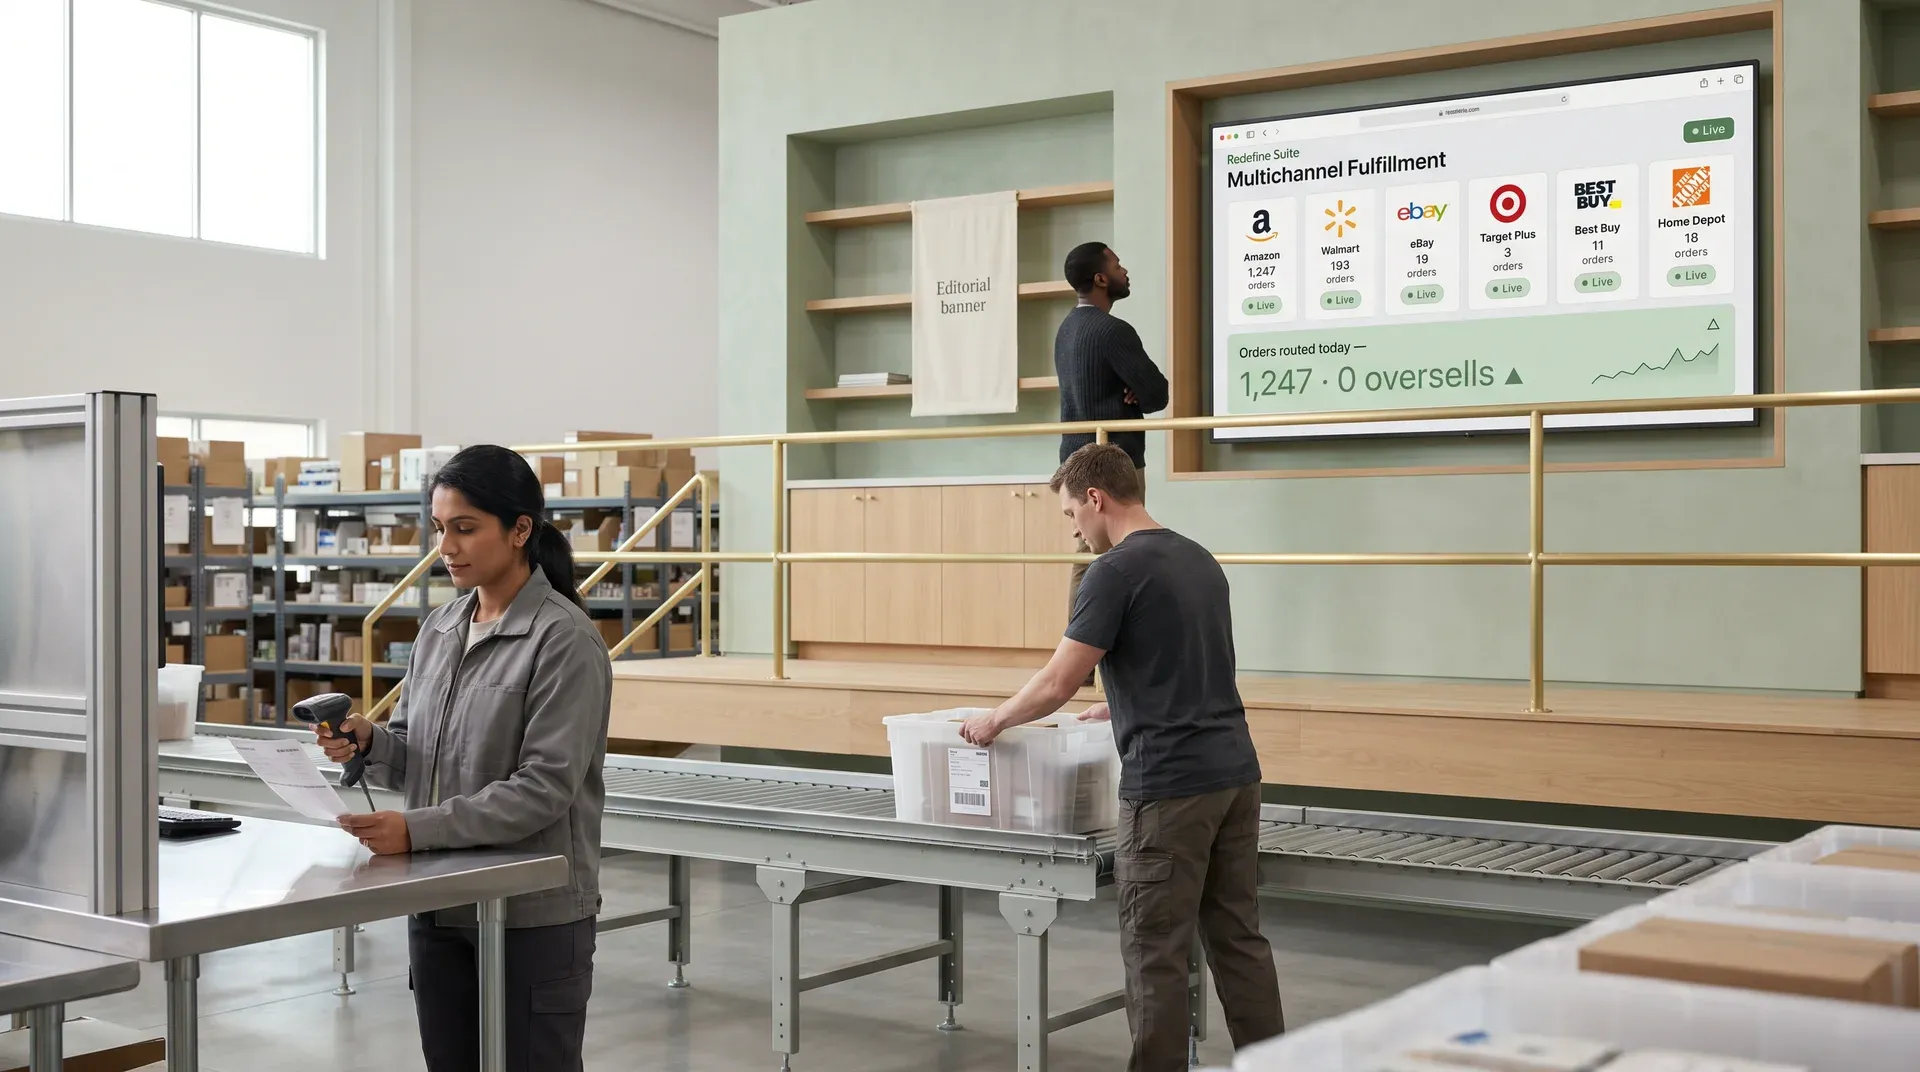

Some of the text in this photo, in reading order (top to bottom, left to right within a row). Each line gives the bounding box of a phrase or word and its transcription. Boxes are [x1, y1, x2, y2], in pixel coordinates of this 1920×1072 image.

[1703, 124, 1726, 136] Live
[1227, 148, 1300, 165] Redefine Suite
[1228, 152, 1446, 188] Multichannel Fulfillment
[1673, 166, 1710, 207] HOME
[1676, 172, 1692, 189] THE
[1574, 180, 1616, 196] BEST
[1577, 194, 1611, 209] BUY
[1397, 201, 1448, 222] ebay
[1252, 209, 1272, 235] a
[1658, 214, 1726, 229] Home Depot
[1574, 223, 1621, 236] Best Buy
[1479, 230, 1536, 244] Target Plus
[1684, 232, 1699, 244] 18
[1320, 244, 1360, 256] Walmart
[1410, 238, 1435, 250] eBay
[1592, 240, 1603, 251] 11
[1243, 252, 1281, 262] Amazon
[1504, 247, 1512, 258] 3
[1674, 247, 1708, 259] orders
[1330, 259, 1350, 271] 193
[1416, 253, 1429, 265] 19
[1581, 255, 1614, 265] orders
[1247, 265, 1276, 278] 1,247
[1492, 262, 1524, 272] orders
[1325, 274, 1355, 285] orders
[1406, 268, 1437, 279] orders
[1685, 270, 1707, 281] Live
[936, 276, 991, 296] Editorial
[1248, 280, 1276, 290] orders
[1592, 277, 1614, 287] Live
[1416, 289, 1437, 299] Live
[1502, 283, 1523, 294] Live
[1256, 301, 1275, 311] Live
[1335, 295, 1355, 305] Live
[940, 300, 987, 315] banner
[1239, 346, 1277, 359] Orders
[1279, 343, 1316, 356] routed
[1318, 341, 1351, 356] today
[1240, 368, 1313, 402] 1,247
[1338, 365, 1356, 393] 0
[1365, 359, 1495, 392] oversells
